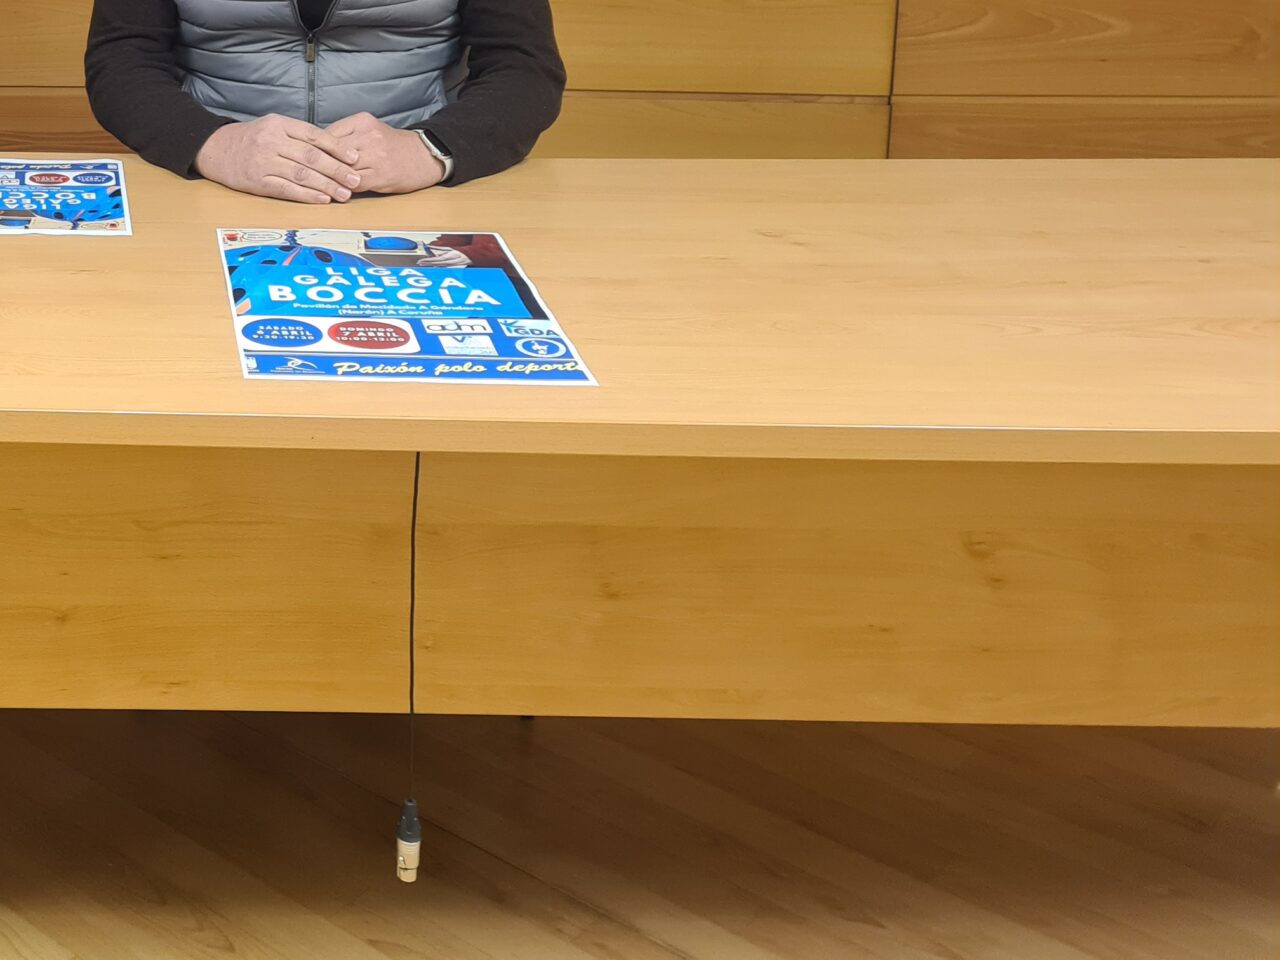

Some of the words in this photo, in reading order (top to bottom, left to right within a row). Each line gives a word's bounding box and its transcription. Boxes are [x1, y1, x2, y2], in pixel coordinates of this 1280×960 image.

[326, 266, 424, 277] LIGA
[293, 274, 467, 288] GALEGA
[268, 284, 502, 306] BOCCIA
[333, 362, 426, 376] Paixón
[434, 361, 488, 375] polo
